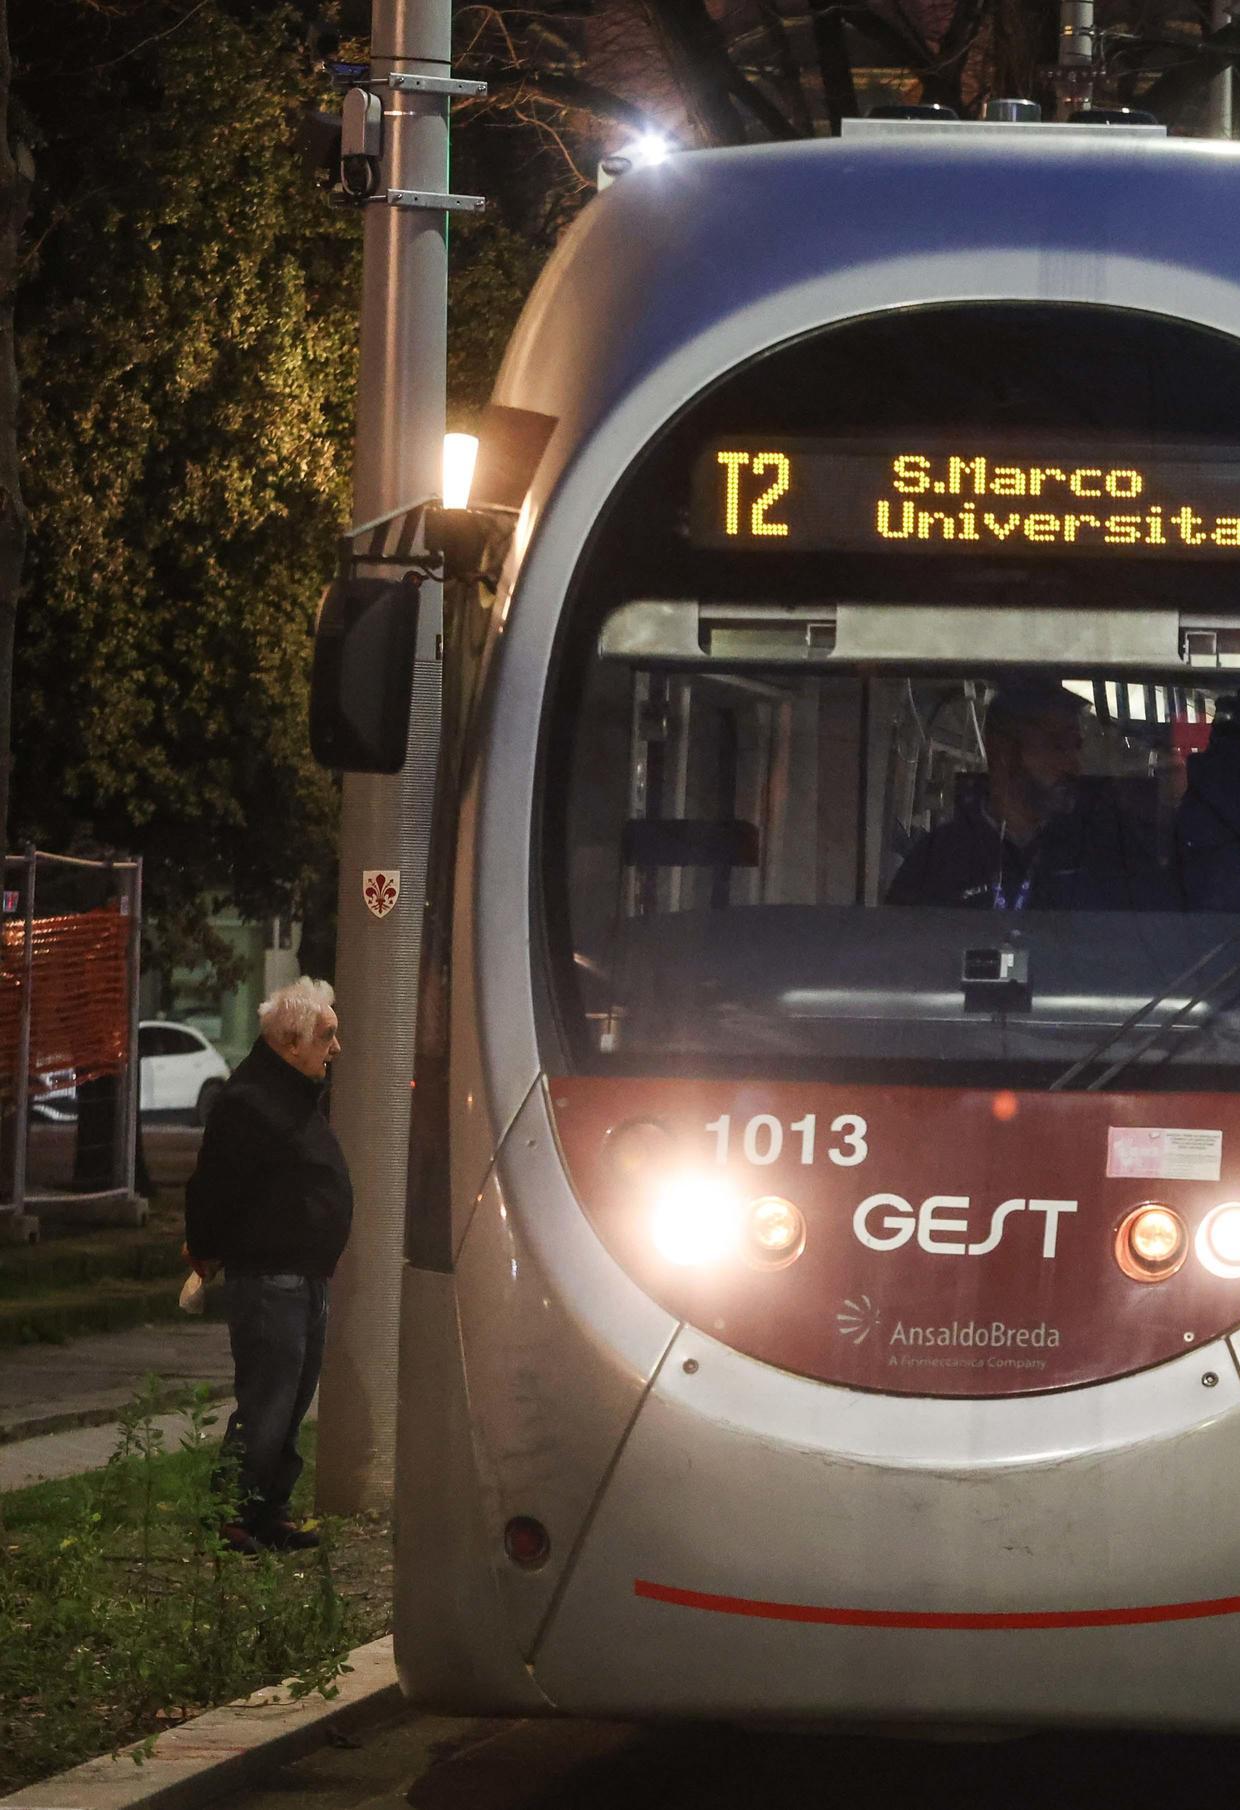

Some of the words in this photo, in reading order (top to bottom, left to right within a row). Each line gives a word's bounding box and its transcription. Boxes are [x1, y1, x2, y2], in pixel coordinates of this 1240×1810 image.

[716, 451, 790, 536] T2
[892, 455, 1143, 498] S.Marco
[705, 1113, 869, 1167] 1013
[852, 1192, 1078, 1258] GEST
[888, 1320, 1061, 1347] AnsaldoBreda
[988, 1357, 1048, 1370] Company
